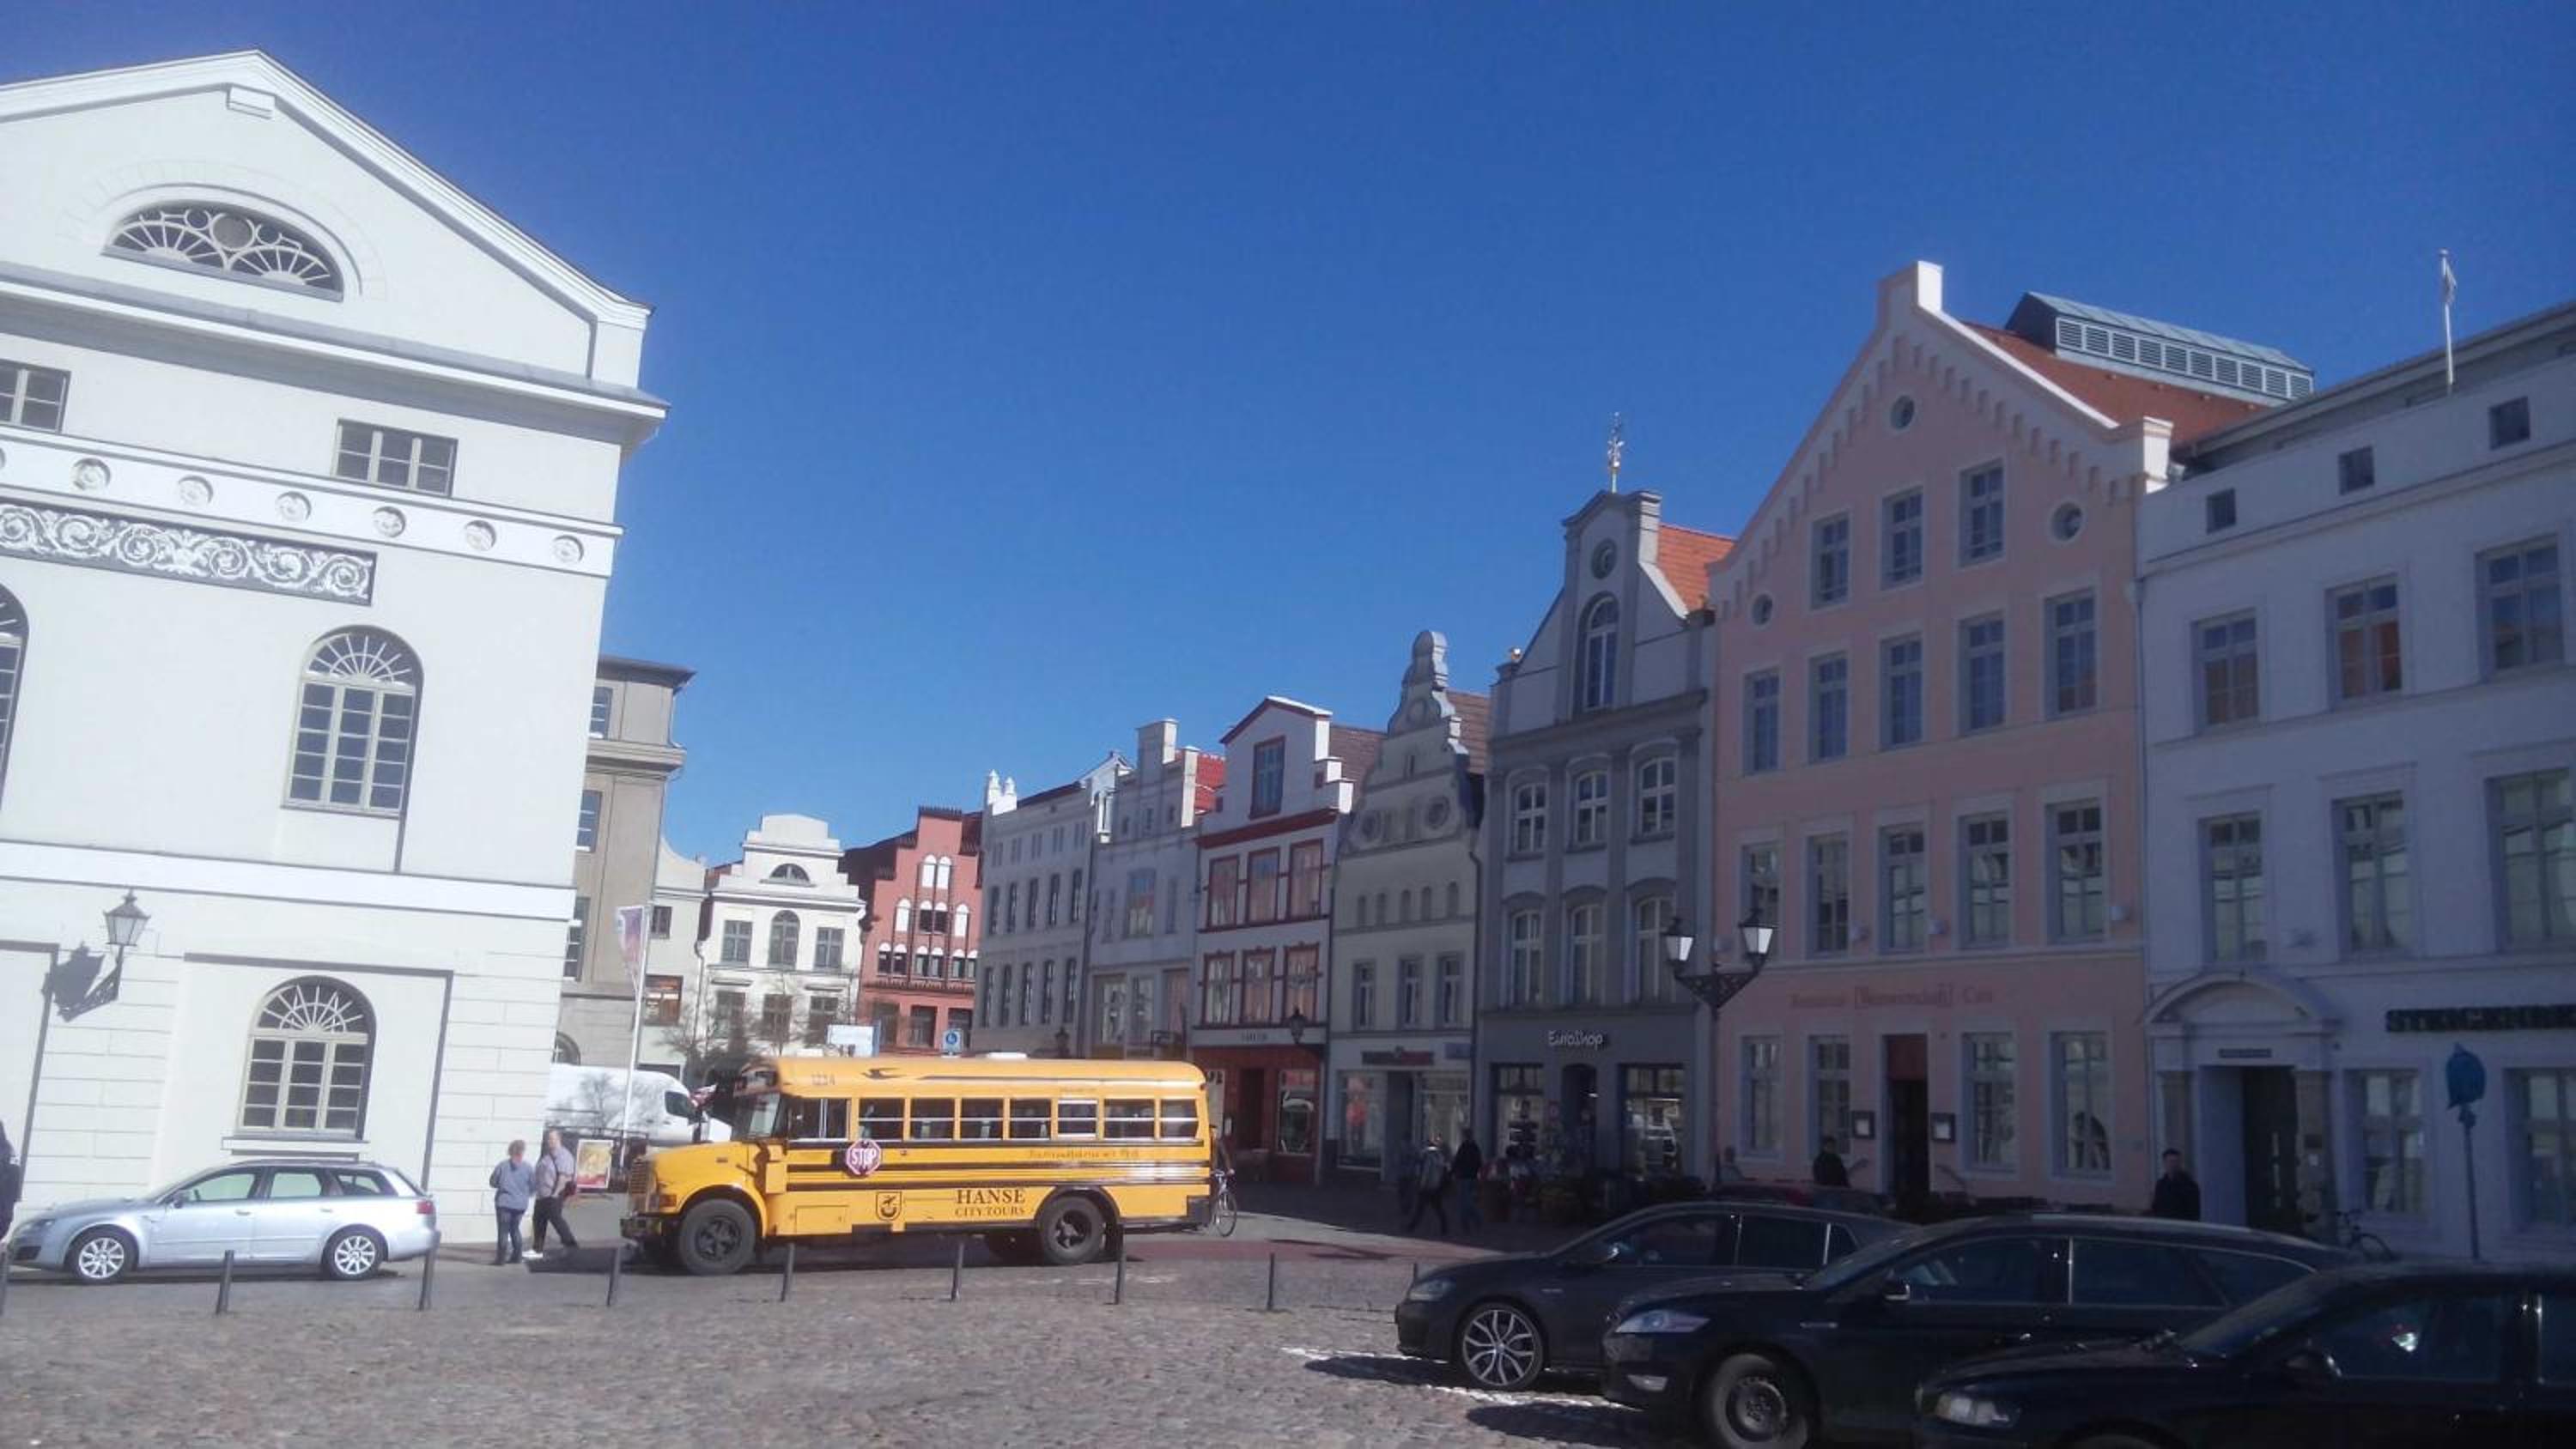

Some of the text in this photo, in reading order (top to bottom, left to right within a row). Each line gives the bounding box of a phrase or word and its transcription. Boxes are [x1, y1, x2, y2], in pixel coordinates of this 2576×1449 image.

[852, 1148, 878, 1167] STOP
[957, 1189, 1025, 1204] HANSE
[955, 1206, 1026, 1217] CITY TOURS
